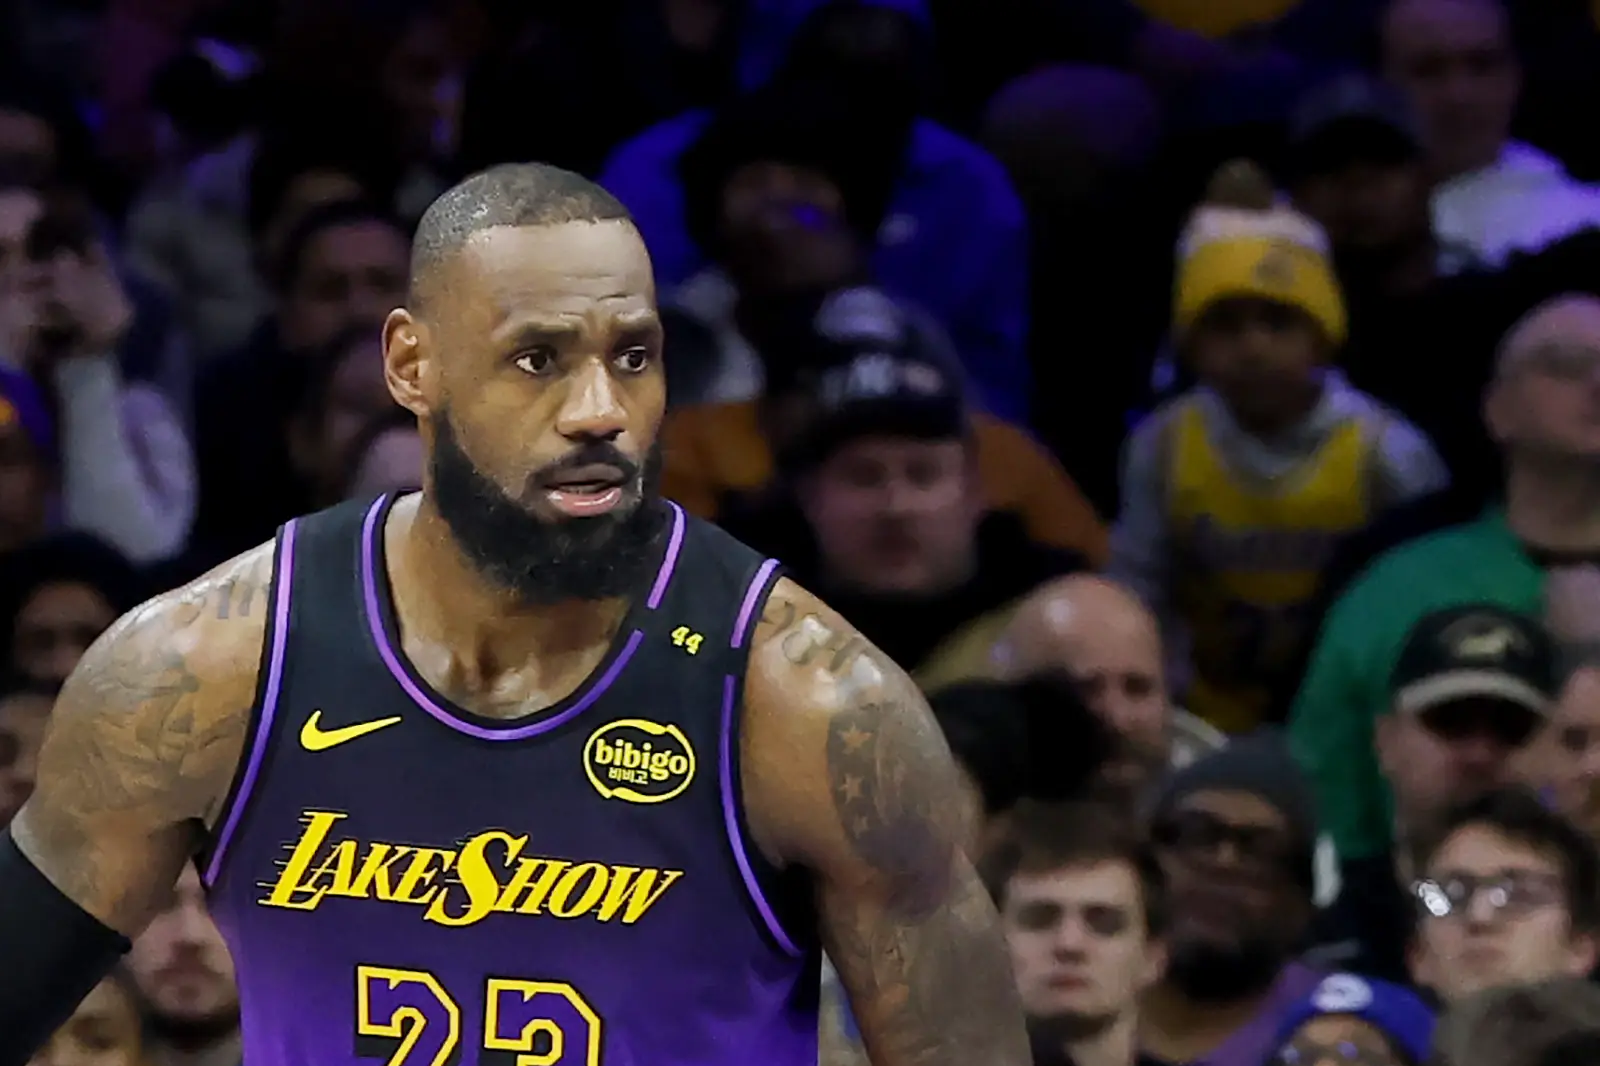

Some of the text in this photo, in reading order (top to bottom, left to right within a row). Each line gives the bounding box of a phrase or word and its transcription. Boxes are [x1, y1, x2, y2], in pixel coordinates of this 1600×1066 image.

[671, 626, 703, 655] 44
[594, 738, 688, 781] bibigo
[607, 767, 649, 785] 비비고
